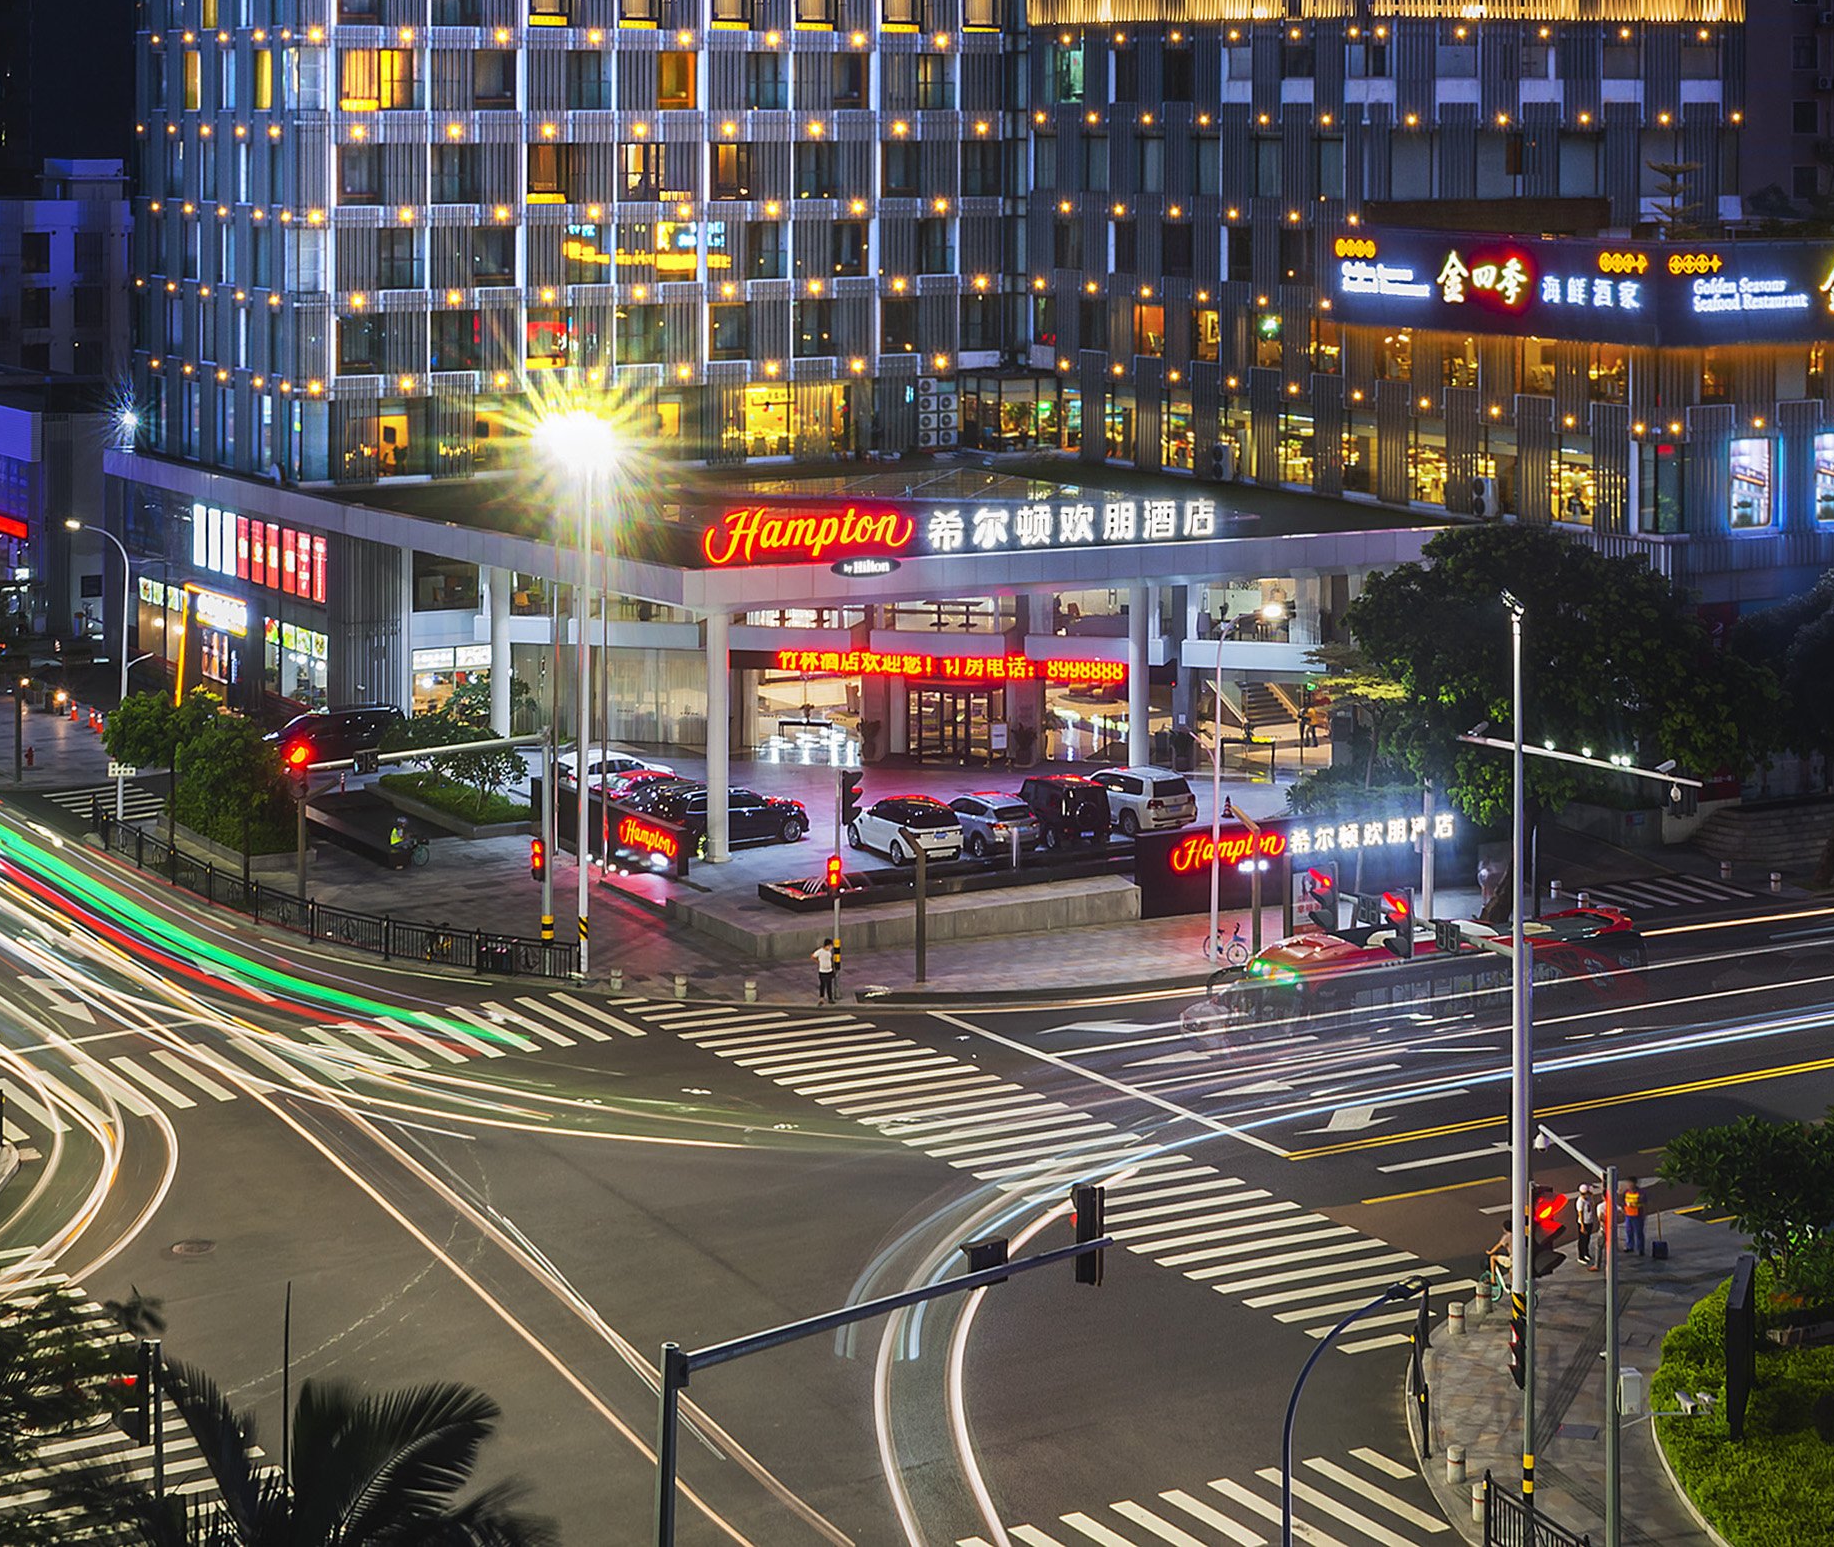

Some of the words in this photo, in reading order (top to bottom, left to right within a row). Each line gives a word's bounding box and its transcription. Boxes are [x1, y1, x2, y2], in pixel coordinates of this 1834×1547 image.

[1437, 250, 1528, 304] 金四季
[1541, 275, 1641, 310] 海鲜酒家
[1693, 277, 1736, 295] Golden
[1739, 277, 1786, 293] Seasons
[1693, 293, 1740, 312] Seafood
[1743, 291, 1809, 310] Restaurant
[703, 506, 915, 563] Hampton
[927, 499, 1217, 552] 希尔顿欢朋酒店
[843, 563, 853, 574] by
[853, 559, 890, 574] Hilton
[1047, 662, 1124, 681] 8998888
[620, 820, 676, 857] Hampton
[1174, 835, 1286, 871] Hamptn
